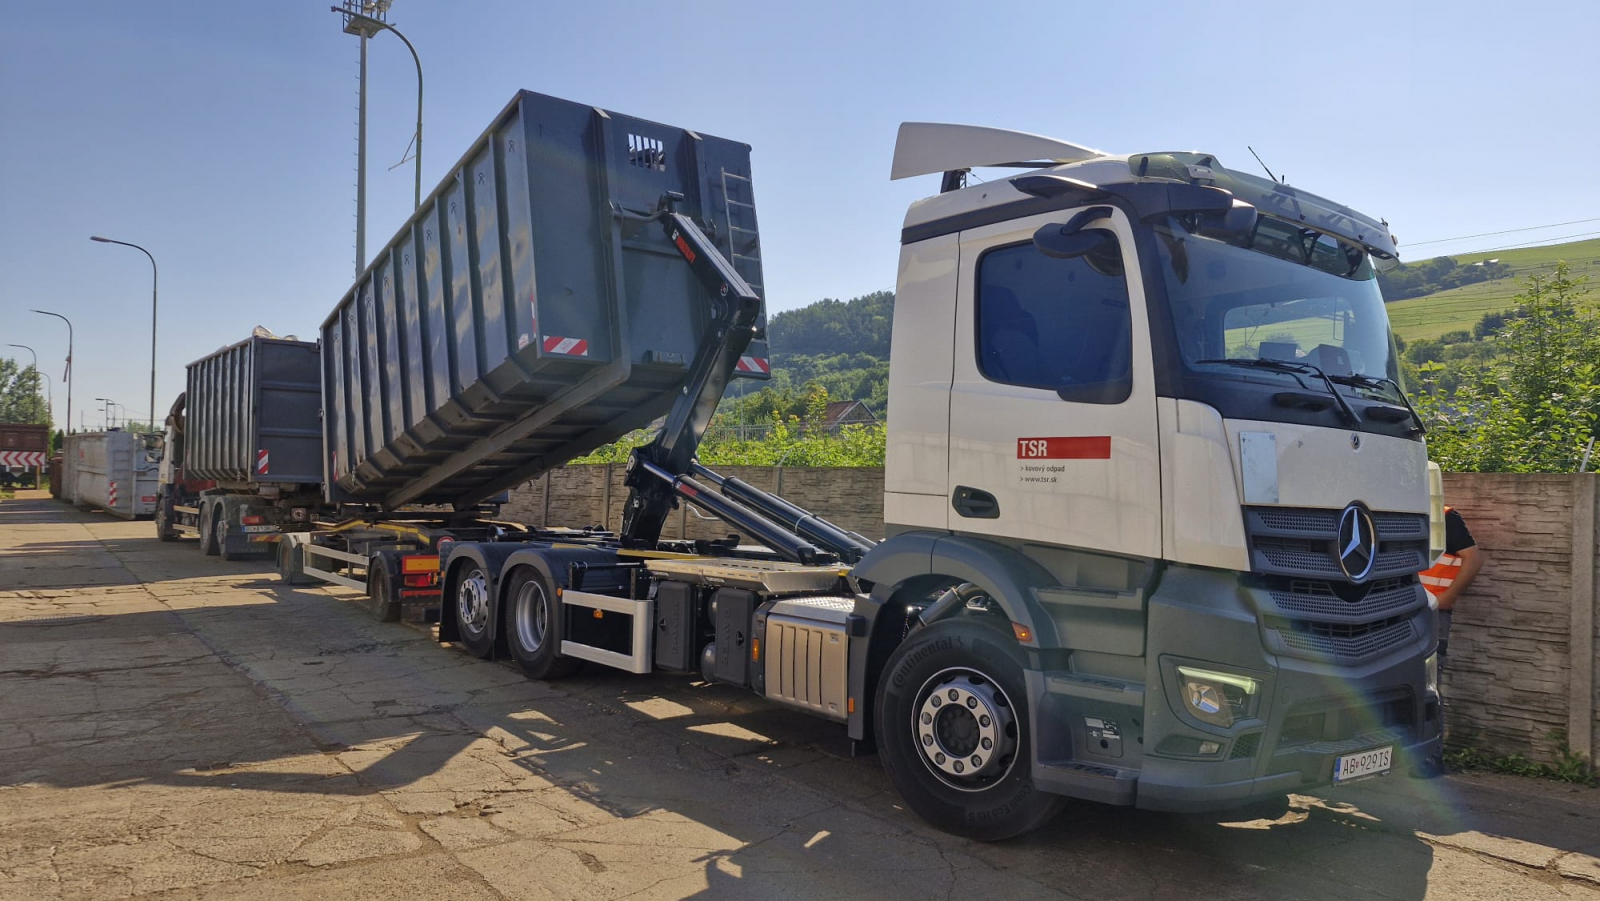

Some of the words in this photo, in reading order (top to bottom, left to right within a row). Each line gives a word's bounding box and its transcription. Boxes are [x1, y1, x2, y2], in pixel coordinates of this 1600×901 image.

[1019, 440, 1048, 457] TSR
[1025, 464, 1045, 473] kovový
[1046, 465, 1065, 473] odpad
[893, 635, 953, 688] Continental
